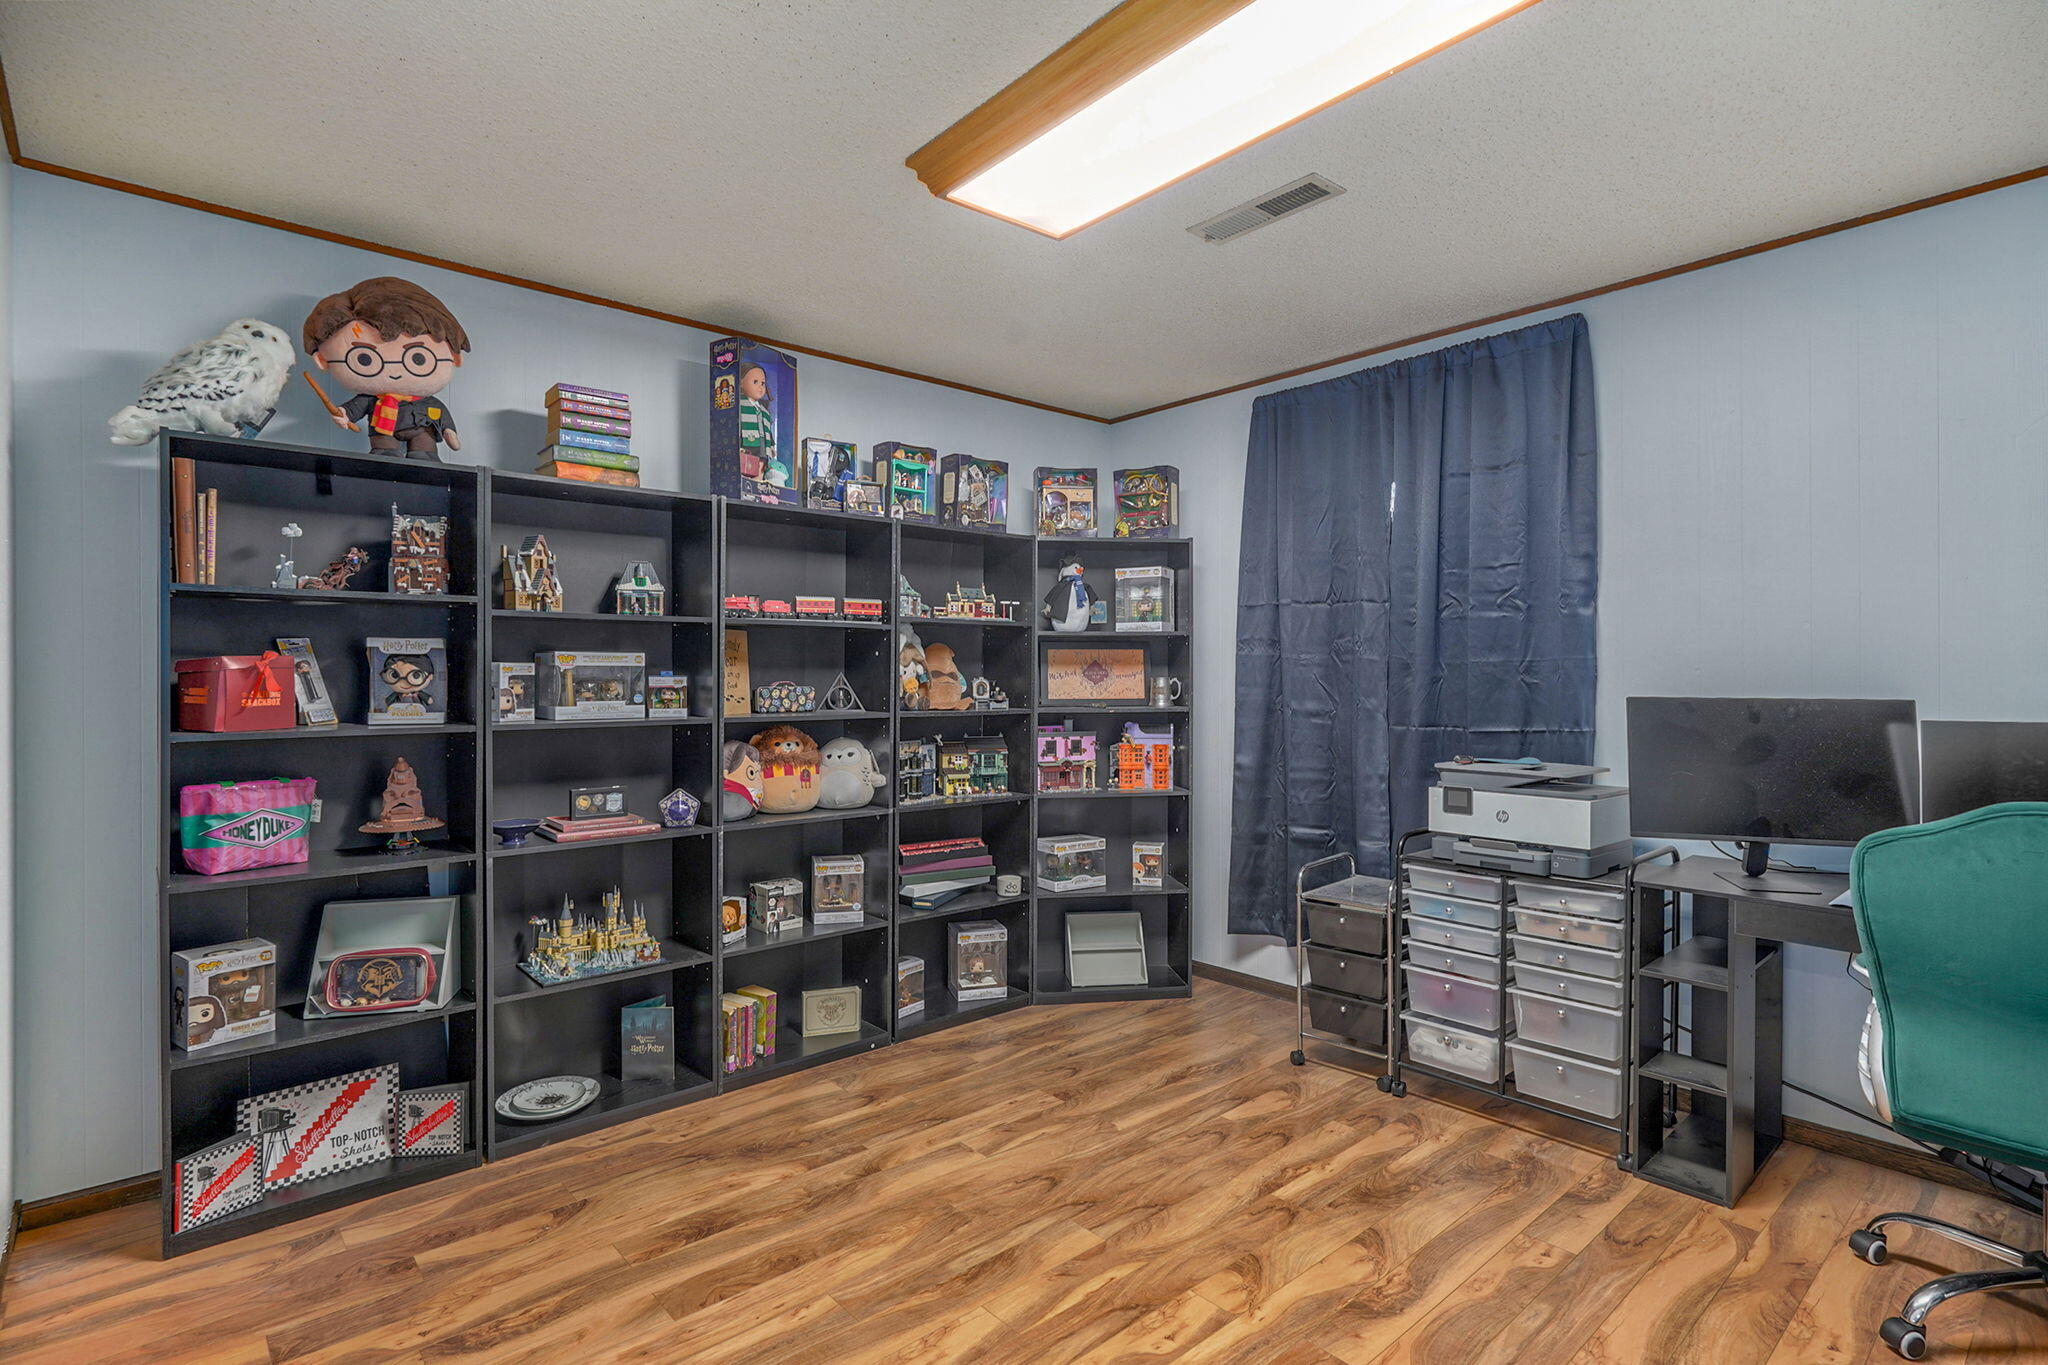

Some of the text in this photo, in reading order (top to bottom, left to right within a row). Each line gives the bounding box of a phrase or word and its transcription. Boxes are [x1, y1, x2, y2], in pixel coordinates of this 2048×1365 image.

[383, 640, 428, 652] Harry Potter
[1496, 810, 1510, 823] hp
[330, 1125, 385, 1148] TOP-NOTCH
[340, 1140, 379, 1159] Shots!
